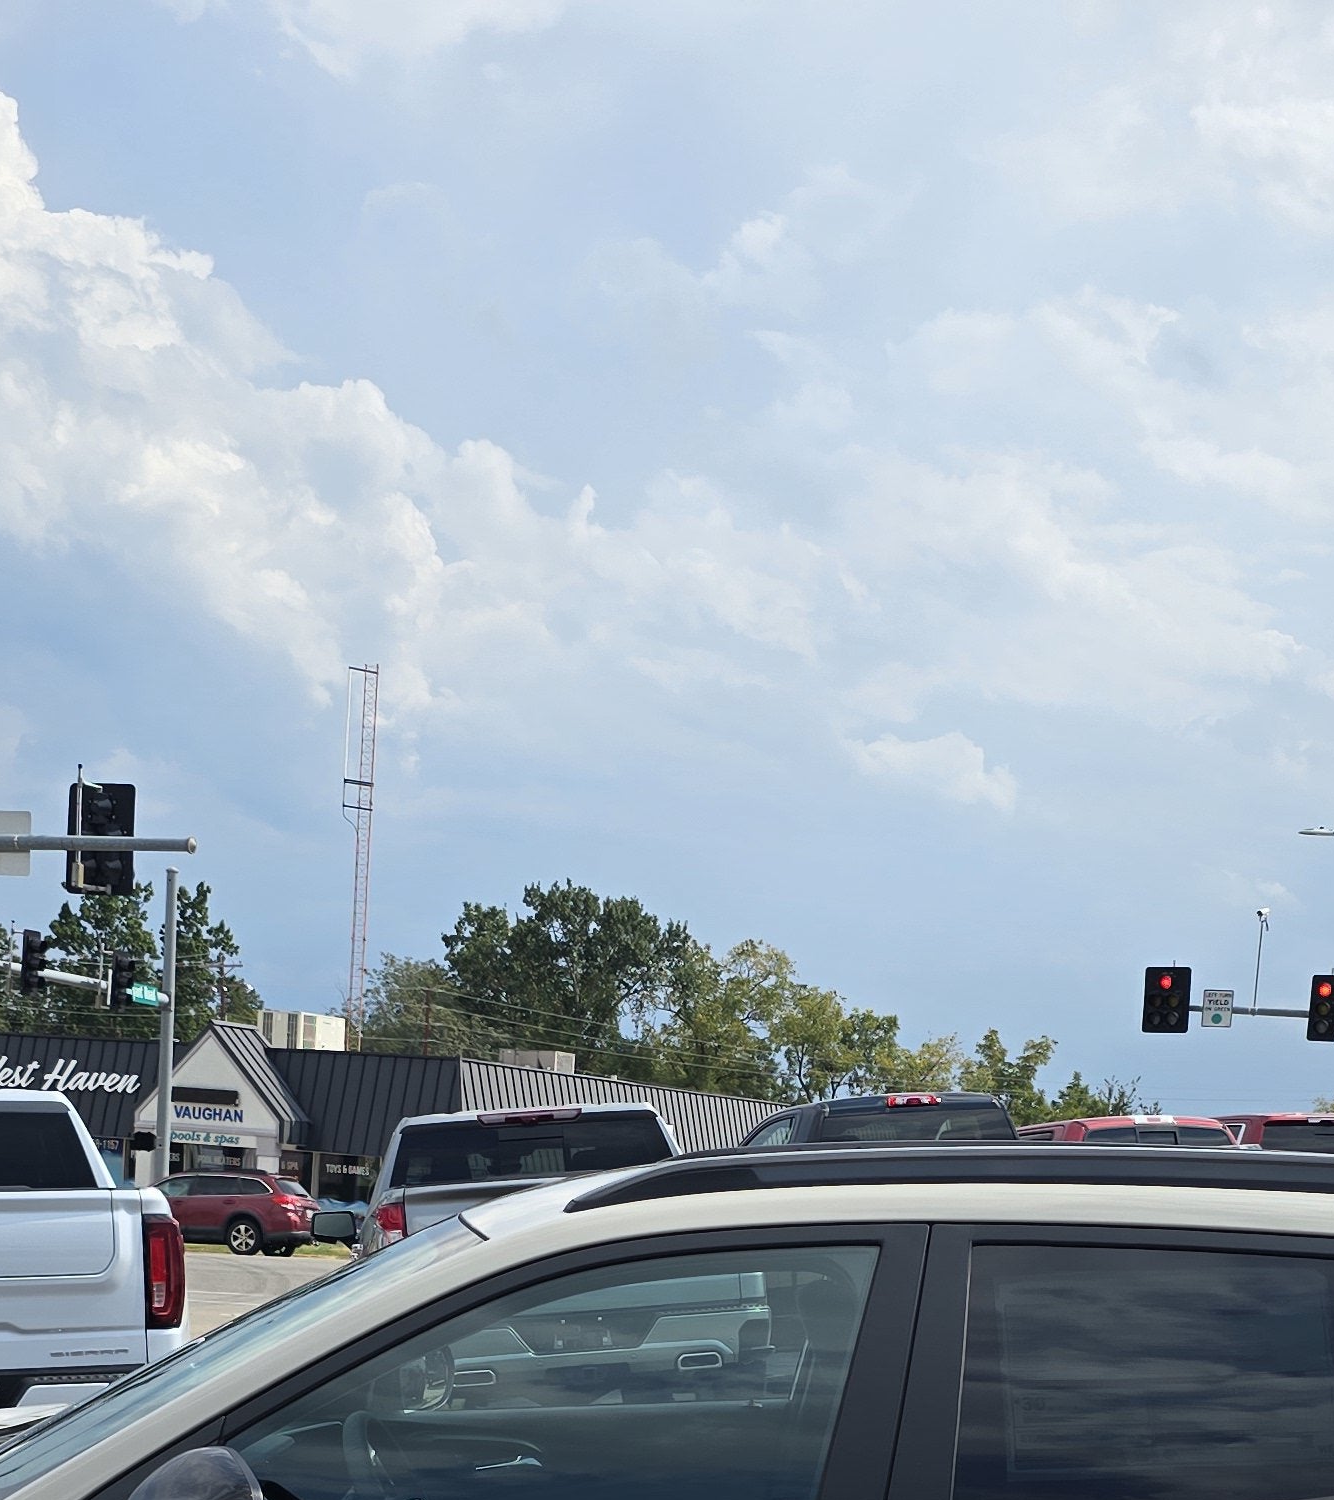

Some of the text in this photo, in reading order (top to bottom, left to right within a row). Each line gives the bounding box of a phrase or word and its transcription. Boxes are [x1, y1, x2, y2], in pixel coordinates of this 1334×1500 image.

[41, 1059, 141, 1094] Haven
[174, 1105, 244, 1123] VAUGHAN
[170, 1131, 201, 1143] pools
[214, 1135, 240, 1146] spas
[326, 1163, 342, 1174] TOYS
[348, 1166, 370, 1176] GAMES
[50, 1348, 129, 1358] SIERRA
